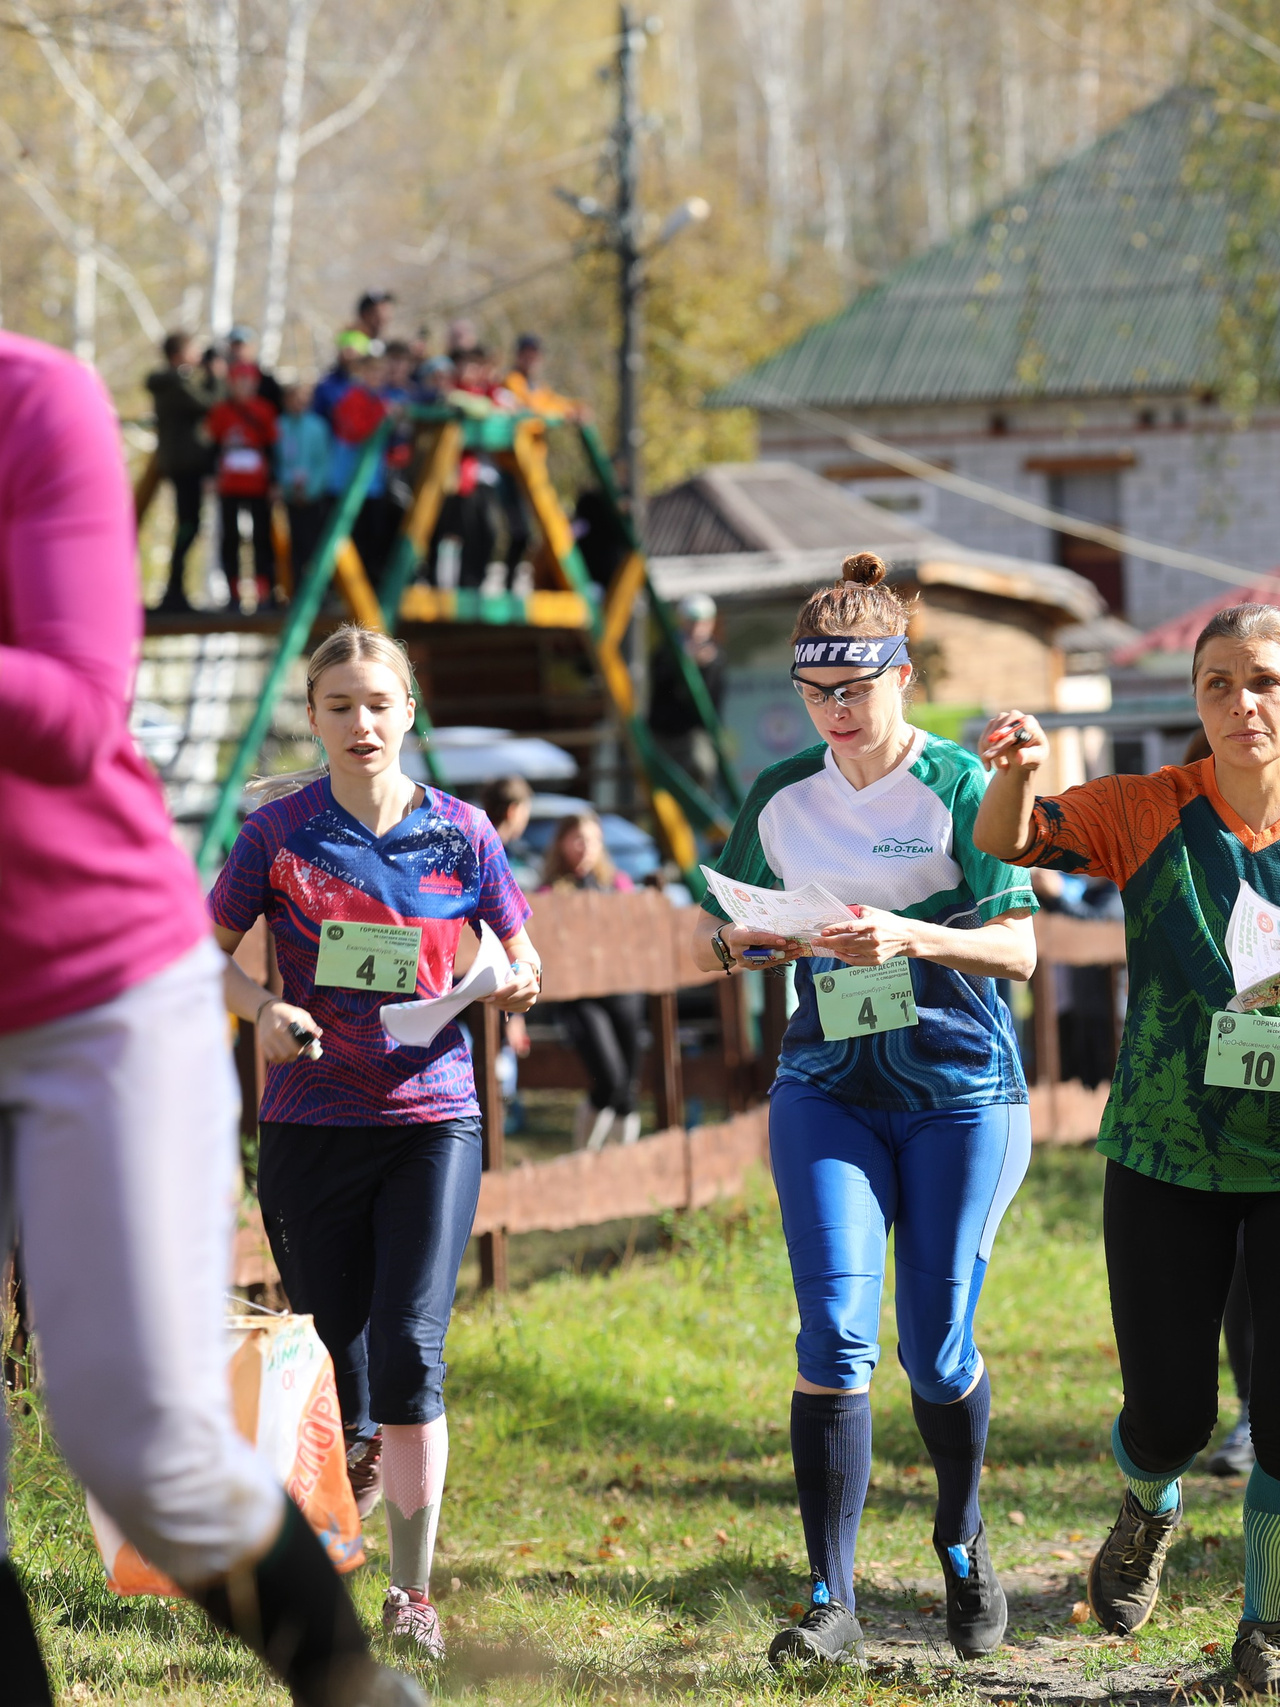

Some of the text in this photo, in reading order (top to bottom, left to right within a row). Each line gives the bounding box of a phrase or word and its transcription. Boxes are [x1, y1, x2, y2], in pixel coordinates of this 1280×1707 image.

[872, 844, 934, 853] EKB-O-TEAM
[356, 955, 376, 986] 4
[393, 958, 415, 967] ЭТАП
[849, 960, 907, 977] ГОРЯЧАЯ ДЕСЯТКА
[396, 967, 407, 988] 2
[890, 990, 912, 1000] ЭТАП
[858, 997, 878, 1030] 4
[900, 1000, 910, 1022] 1
[1241, 1050, 1275, 1087] 10
